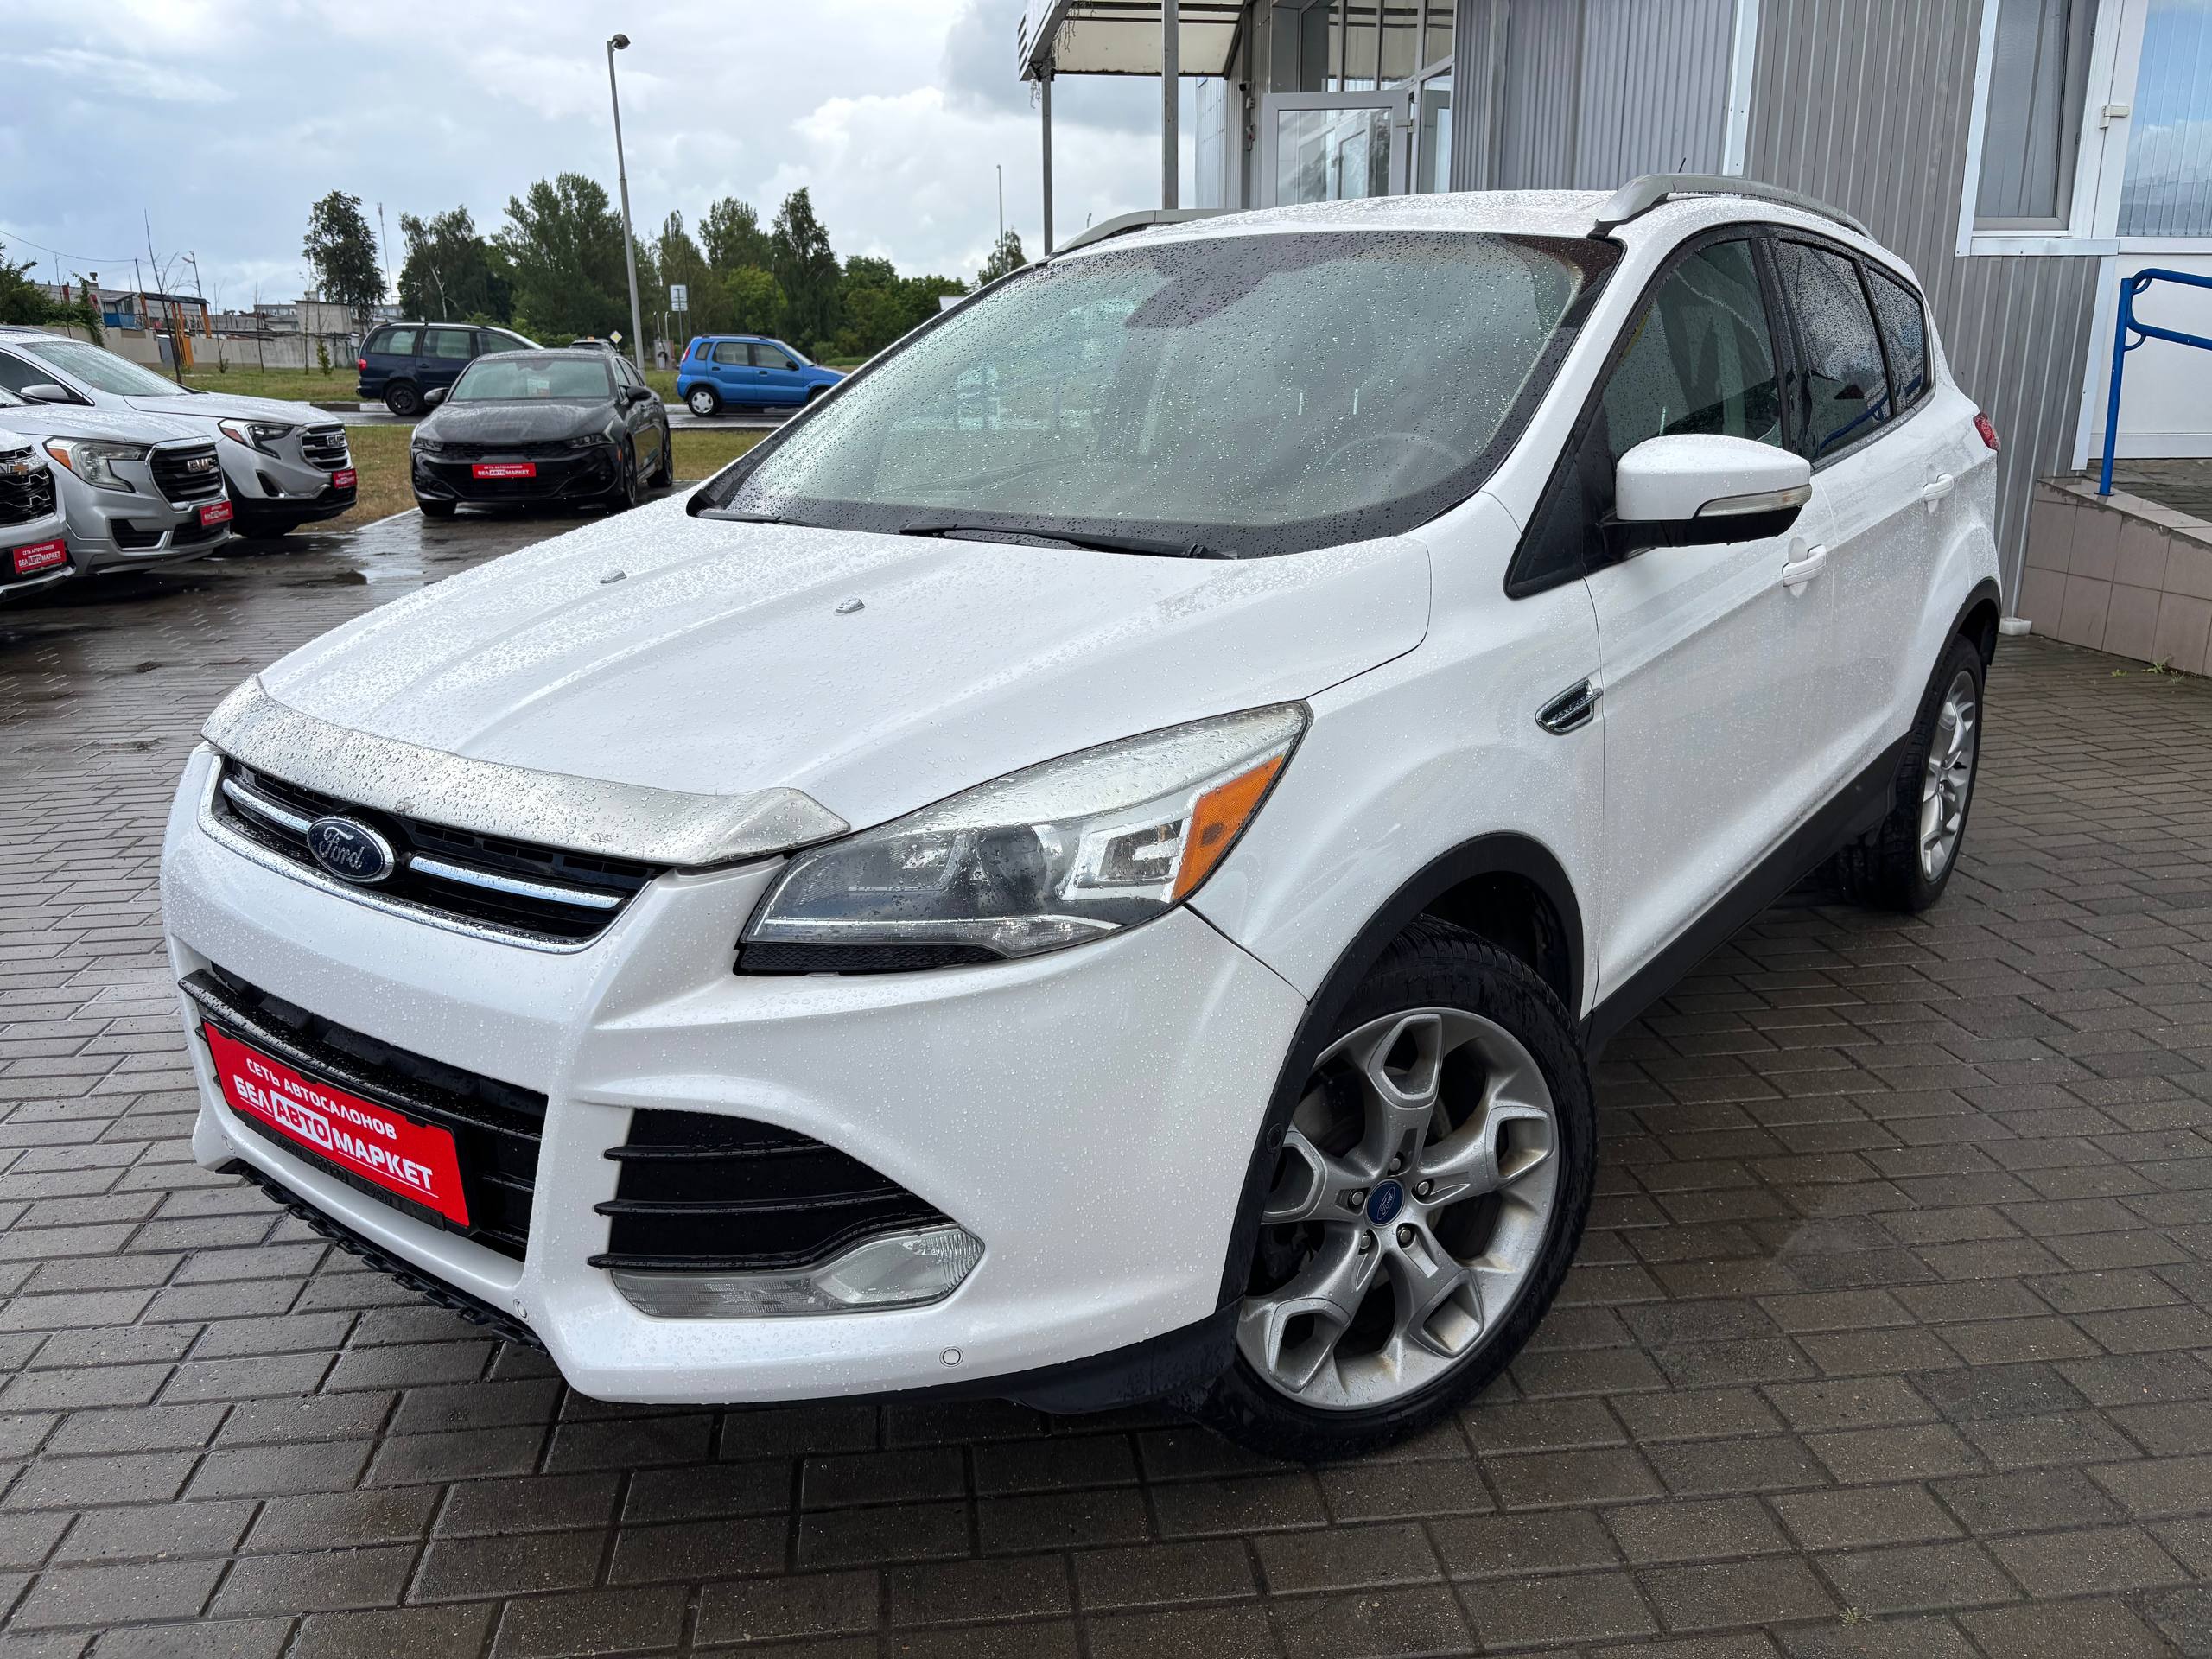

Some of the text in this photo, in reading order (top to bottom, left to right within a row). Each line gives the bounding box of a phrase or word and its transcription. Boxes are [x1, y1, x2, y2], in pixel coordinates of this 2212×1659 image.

[319, 826, 365, 870] Ford
[245, 1058, 397, 1141] СЕТЬ АВТОСАЛОНОВ
[1380, 1192, 1394, 1216] Ford
